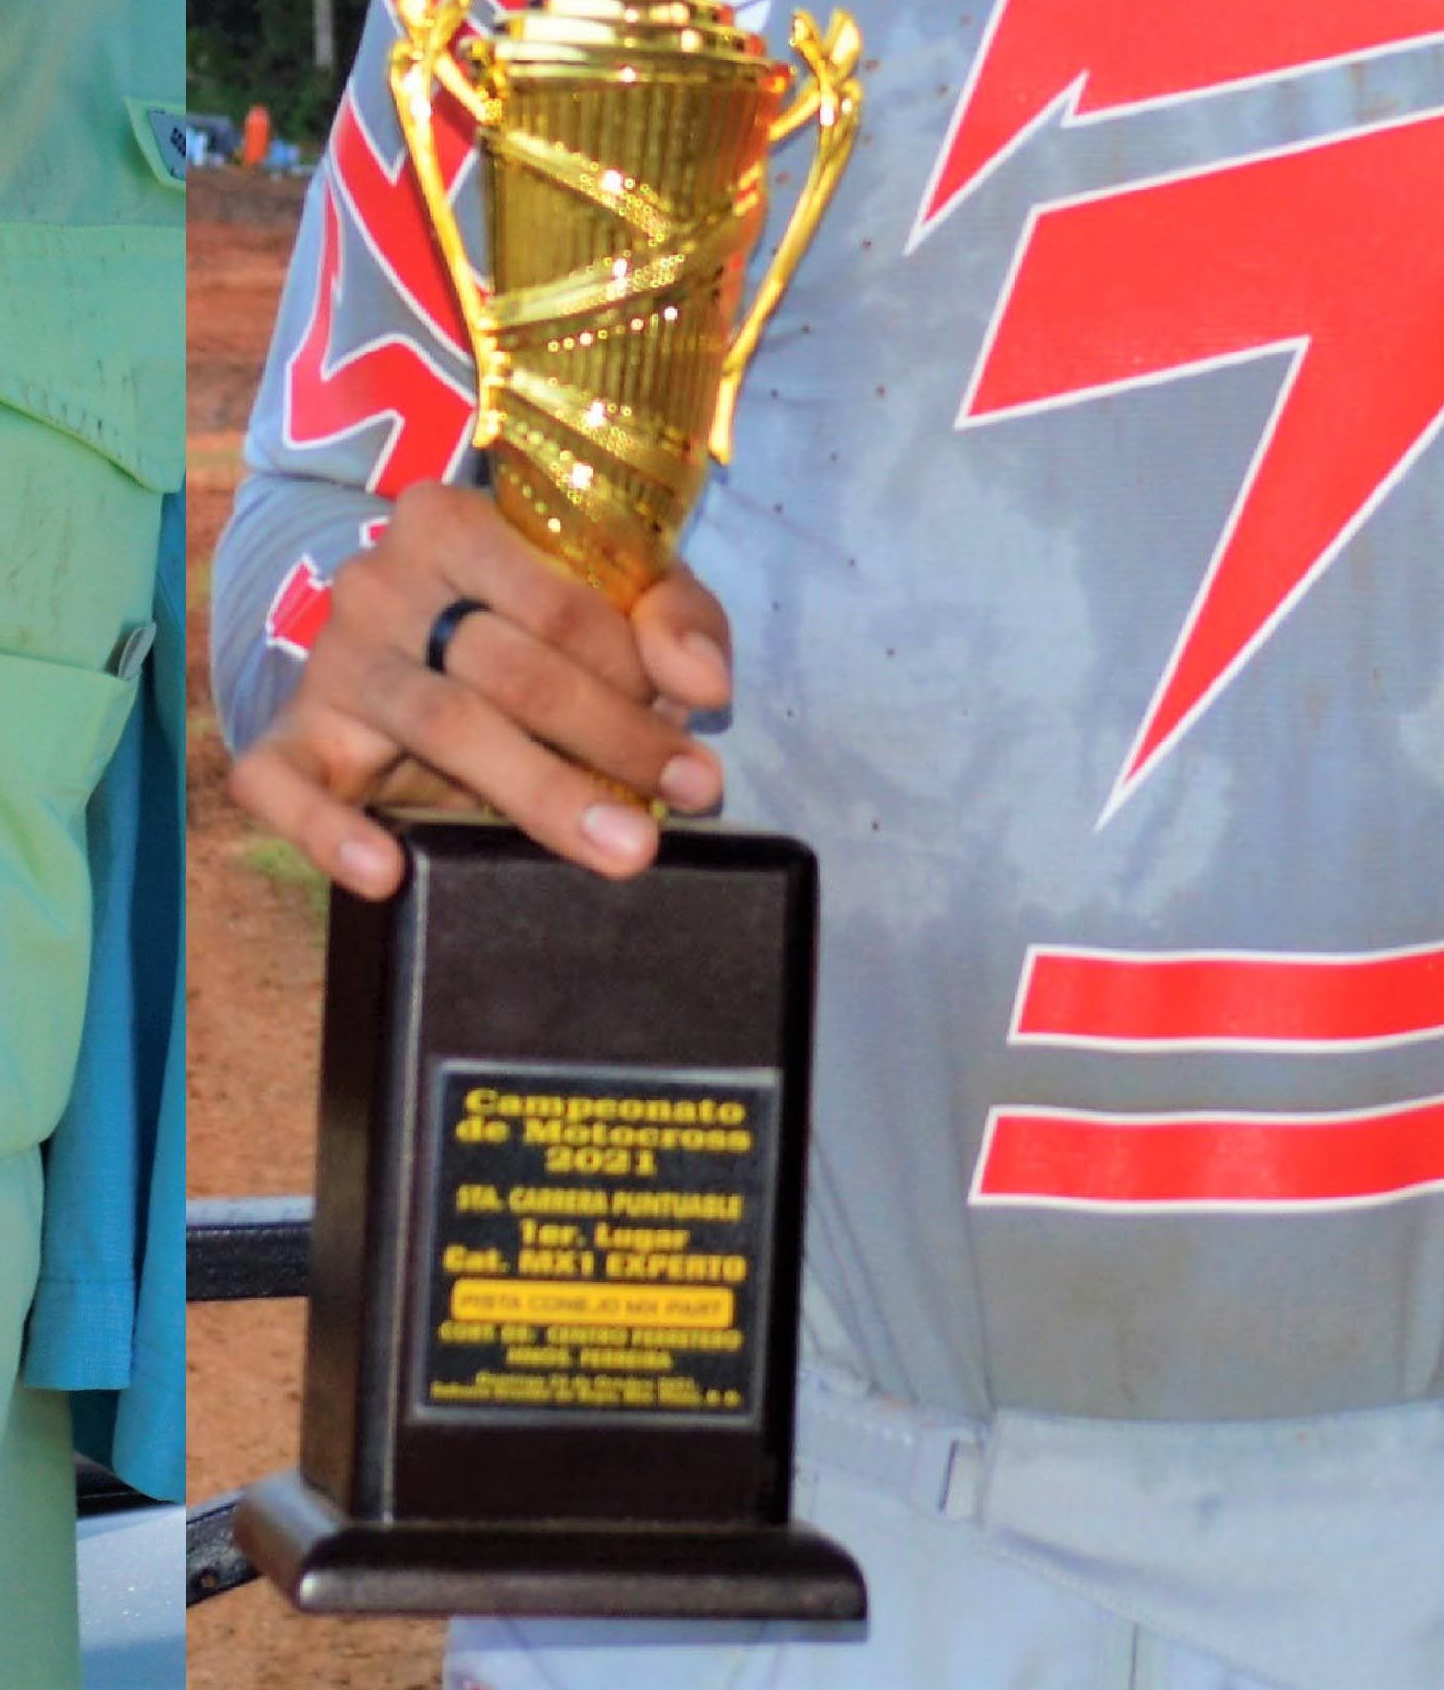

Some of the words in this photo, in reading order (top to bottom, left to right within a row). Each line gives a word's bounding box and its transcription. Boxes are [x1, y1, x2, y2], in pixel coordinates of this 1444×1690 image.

[464, 1087, 747, 1126] Campeonato
[455, 1115, 510, 1144] de
[522, 1116, 753, 1153] Motocross
[544, 1145, 656, 1177] 2021
[508, 1184, 608, 1216] CARRERA
[611, 1189, 745, 1222] PUNTUABLE
[519, 1217, 588, 1248] 1er.
[593, 1220, 691, 1253] Lugar
[442, 1243, 512, 1274] Cat.
[517, 1248, 596, 1278] MX1
[605, 1253, 749, 1283] EXPERTO
[527, 1293, 620, 1313] CONEJO
